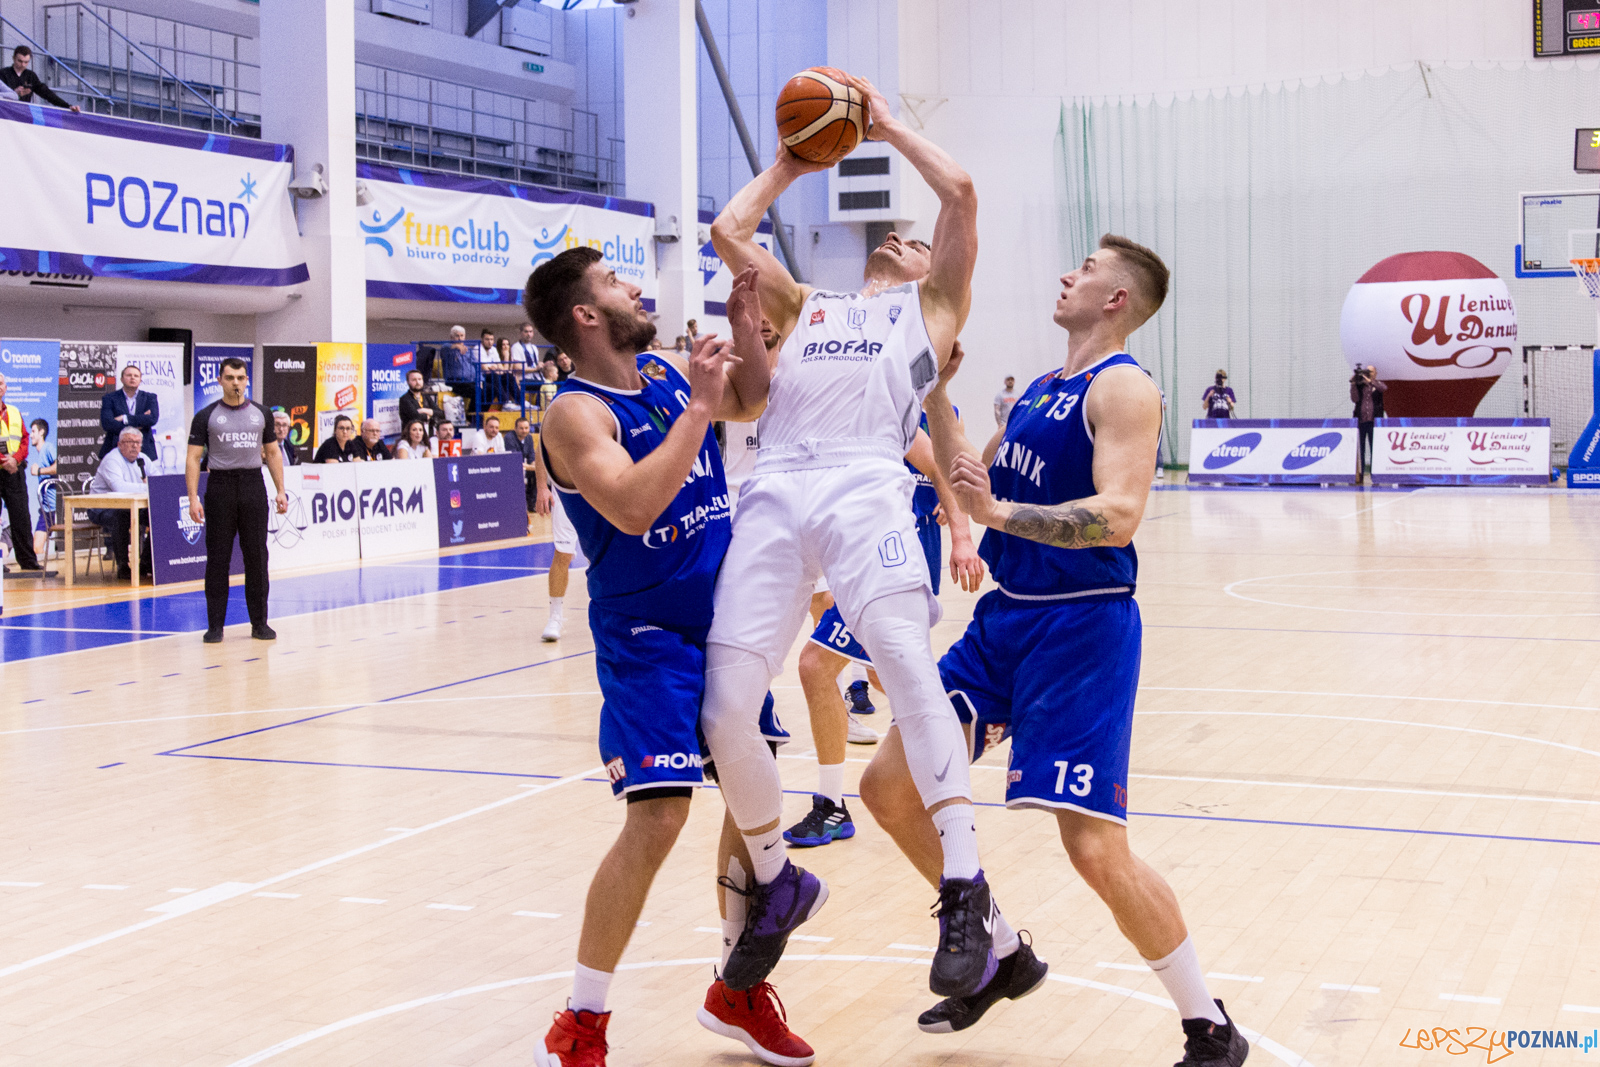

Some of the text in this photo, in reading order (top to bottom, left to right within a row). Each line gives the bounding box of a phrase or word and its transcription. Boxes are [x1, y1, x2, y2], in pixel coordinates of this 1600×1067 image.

[1578, 12, 1600, 30] 47
[403, 212, 510, 253] funclub
[406, 247, 446, 260] biuro
[564, 228, 645, 266] fnclub
[452, 252, 510, 268] podróży
[699, 252, 721, 272] trem
[609, 265, 645, 279] odróży
[1400, 293, 1453, 346] U
[803, 339, 883, 358] BIOFAR
[274, 358, 305, 369] drukma
[318, 361, 360, 371] Słoneczna
[318, 373, 359, 382] witamina
[372, 370, 401, 381] MOCNE
[372, 382, 393, 392] STAWY
[1045, 391, 1079, 421] 13
[1388, 431, 1407, 451] U
[1409, 441, 1449, 452] Danuty
[1467, 431, 1487, 451] U
[1489, 441, 1530, 452] Danuty
[1212, 444, 1251, 457] atrem
[1291, 444, 1330, 457] atrem
[995, 436, 1046, 488] RNIK
[312, 485, 424, 524] BIOFARM
[828, 621, 850, 648] 15
[984, 723, 1005, 752] Spo
[653, 752, 703, 769] RON
[1054, 760, 1094, 797] 13
[1113, 783, 1128, 808] TO
